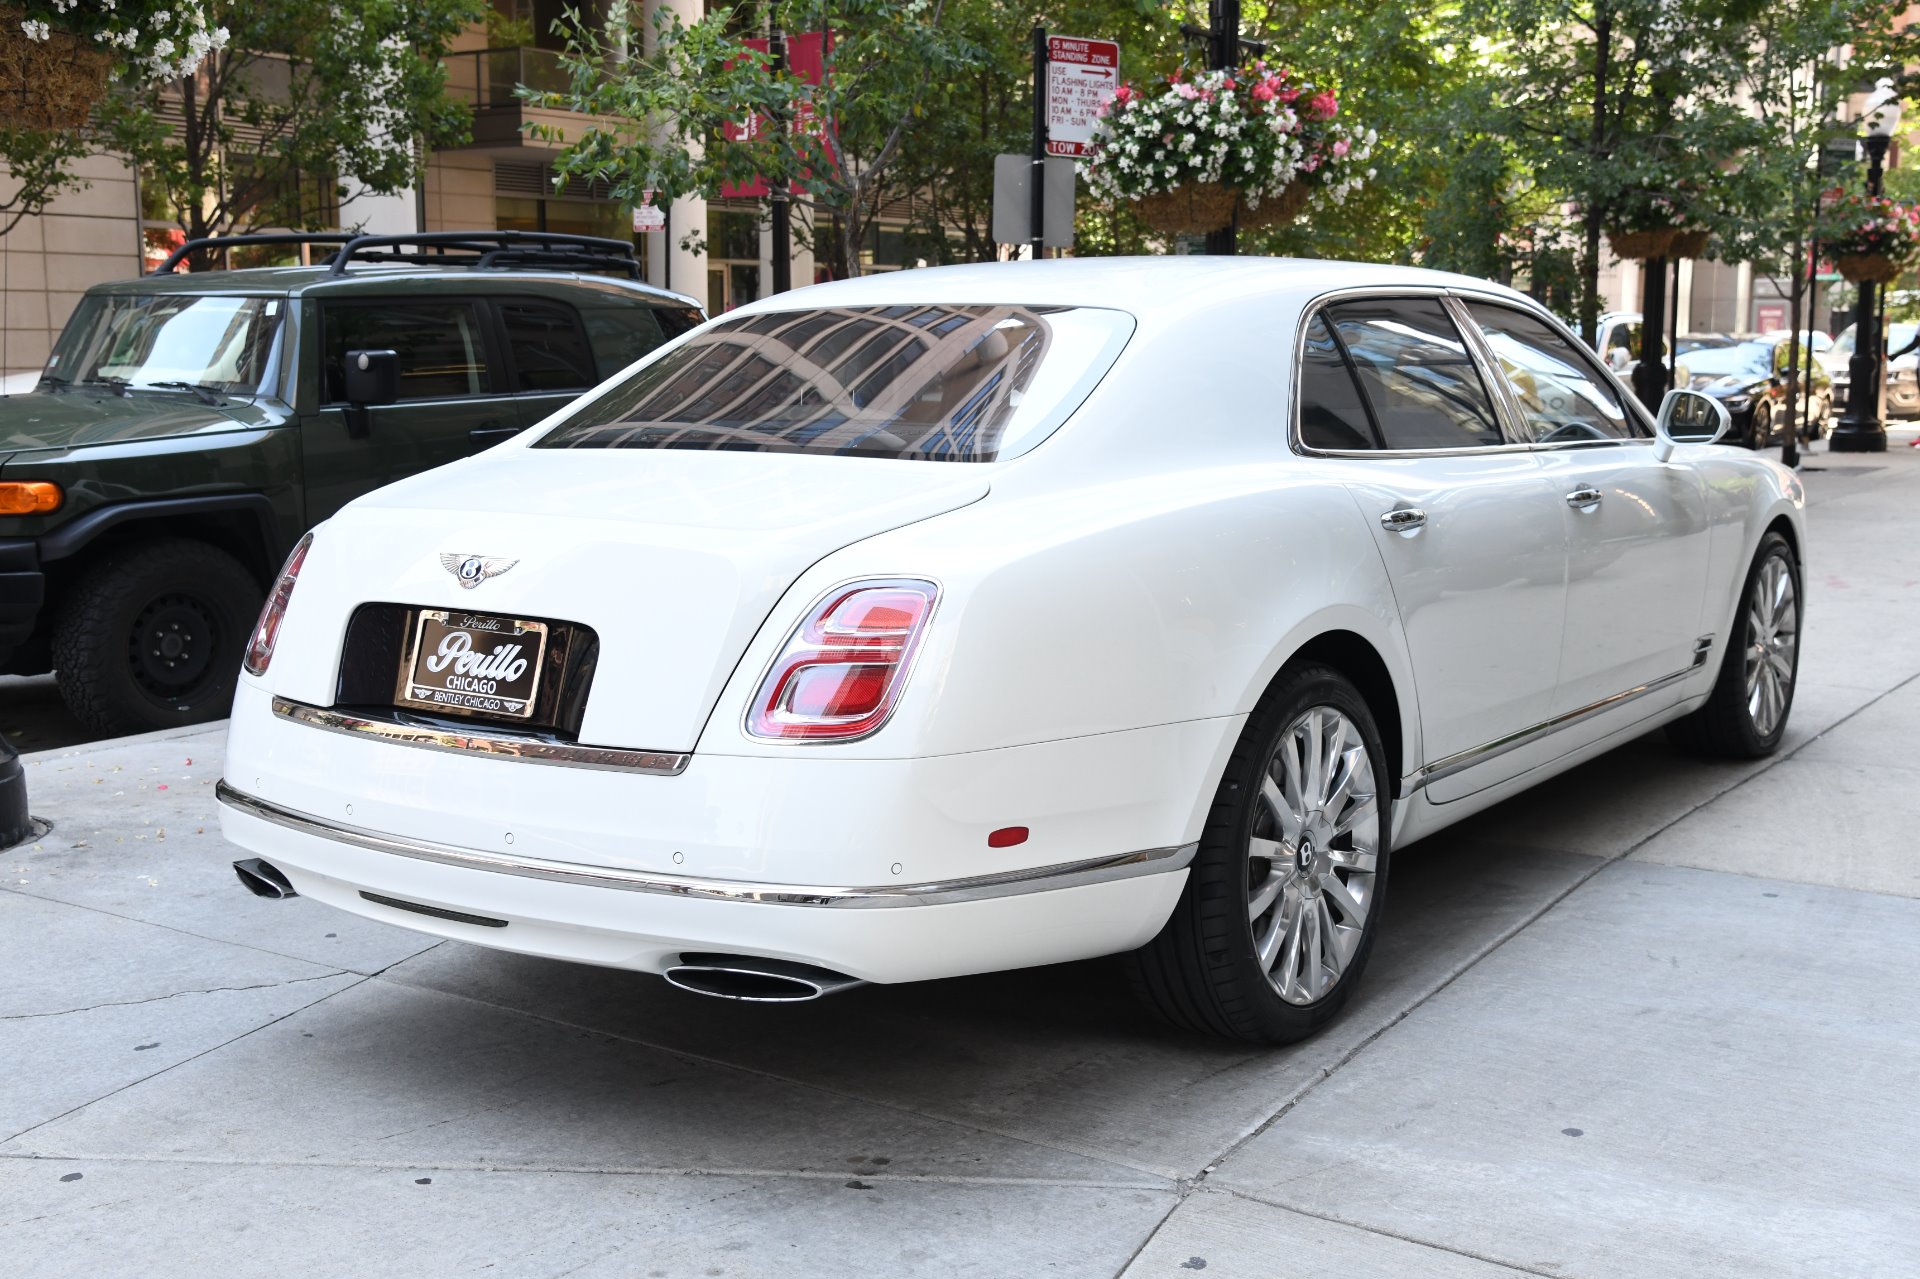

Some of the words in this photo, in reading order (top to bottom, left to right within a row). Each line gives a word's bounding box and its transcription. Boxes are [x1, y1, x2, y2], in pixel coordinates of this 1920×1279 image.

[1052, 40, 1060, 50] 15
[1062, 41, 1089, 53] MINUTE
[1052, 50, 1088, 63] STANDING
[1091, 54, 1111, 65] ZONE
[1051, 66, 1066, 76] USE
[1051, 76, 1087, 88] FLASHING
[1089, 79, 1114, 91] LIGHTS
[1052, 86, 1060, 95] 10
[1061, 87, 1073, 96] AM
[1087, 89, 1098, 98] PM
[1051, 96, 1068, 105] MON
[1077, 98, 1101, 109] THURS
[1052, 105, 1060, 115] 10
[1061, 106, 1072, 115] AM
[1086, 108, 1097, 118] PM
[1051, 115, 1064, 125] FRI
[1071, 117, 1087, 127] SUN
[1051, 141, 1075, 154] TOW
[460, 615, 500, 630] Perillo
[426, 631, 528, 682] Perillo
[446, 675, 497, 695] CHICAGO
[434, 691, 464, 706] BENTLEY
[464, 694, 500, 710] CHICAGO
